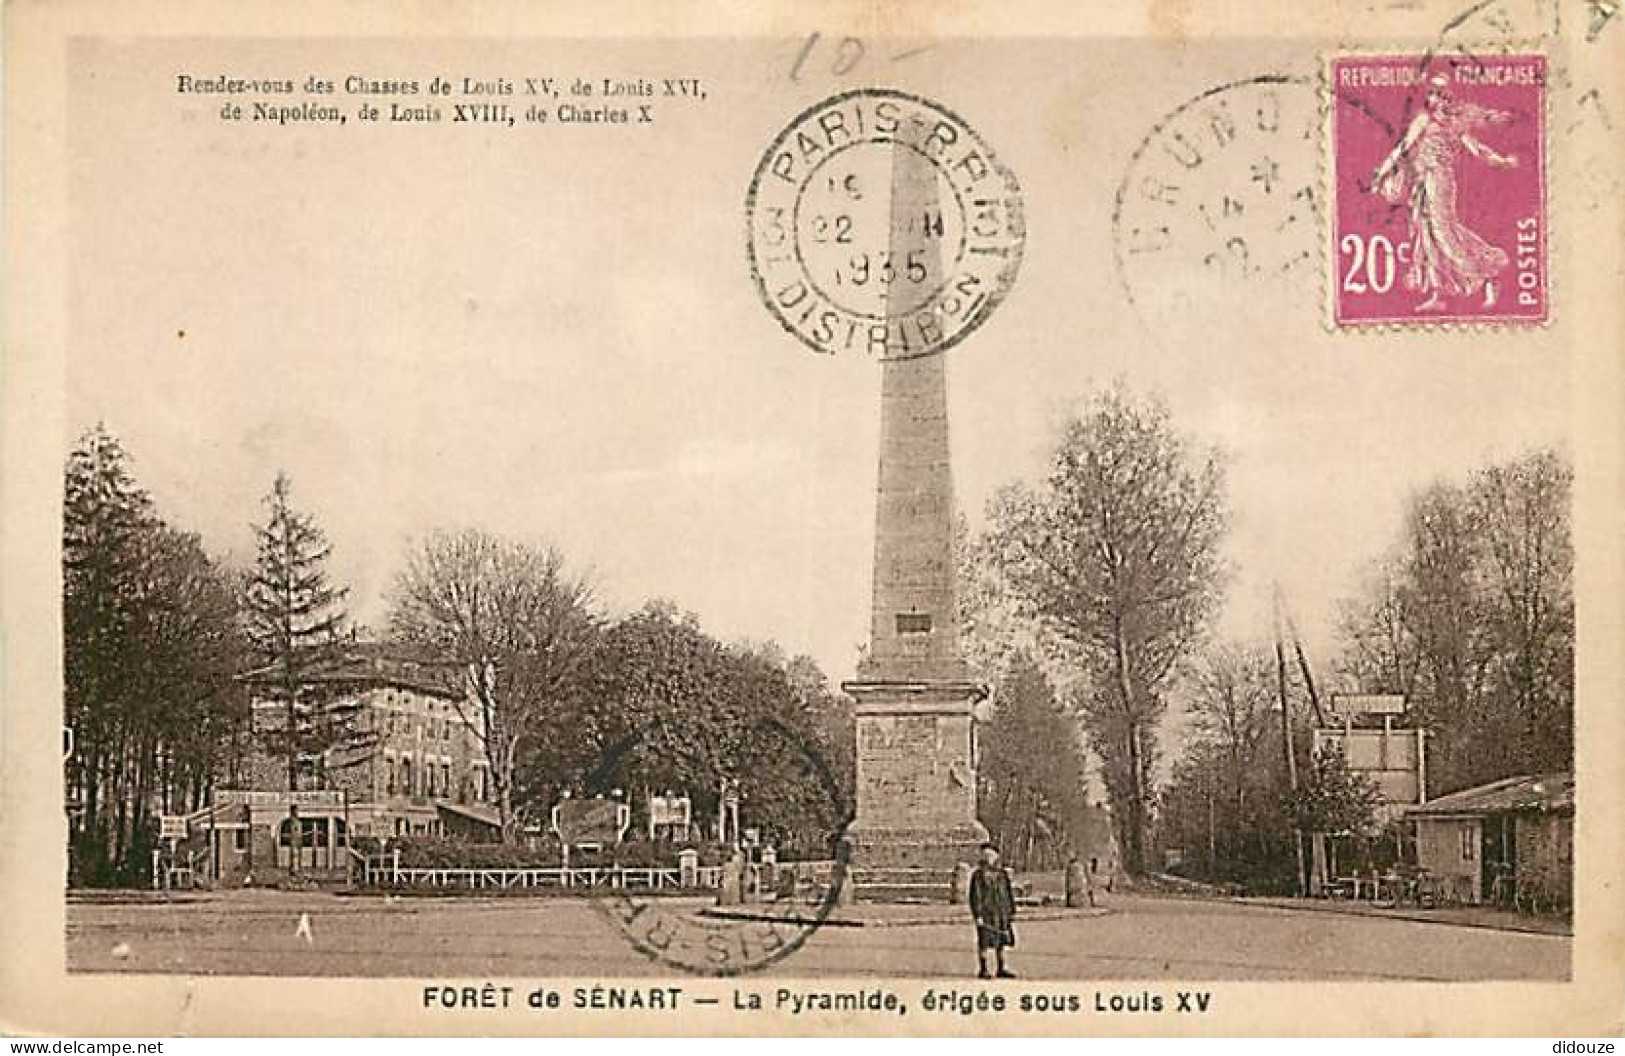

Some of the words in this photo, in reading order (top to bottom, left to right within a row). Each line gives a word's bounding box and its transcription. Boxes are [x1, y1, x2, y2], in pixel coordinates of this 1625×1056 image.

[177, 75, 294, 95] Rendez-vous
[303, 75, 335, 95] des
[345, 75, 420, 95] Chasses
[429, 76, 451, 96] de
[463, 77, 514, 95] Louis
[525, 77, 559, 99] XV,
[570, 77, 592, 96] de
[602, 79, 654, 96] Louis
[662, 79, 707, 100] XVI,
[220, 103, 242, 121] de
[253, 102, 347, 125] Napoléon,
[358, 103, 379, 121] de
[390, 103, 442, 122] Louis
[452, 104, 515, 127] XVIII,
[526, 104, 548, 122] de
[557, 104, 629, 122] Charles
[638, 105, 653, 122] X
[836, 249, 928, 287] 1935
[1517, 217, 1538, 305] POSTES
[423, 983, 514, 1009] FORÊT
[528, 988, 561, 1009] de
[573, 983, 683, 1010] SÉNART
[733, 989, 763, 1011] La
[776, 988, 907, 1016] Pyramide,
[921, 990, 1007, 1016] érigée
[1019, 993, 1081, 1013] sous
[1095, 991, 1165, 1013] Louis
[1177, 992, 1212, 1013] XV
